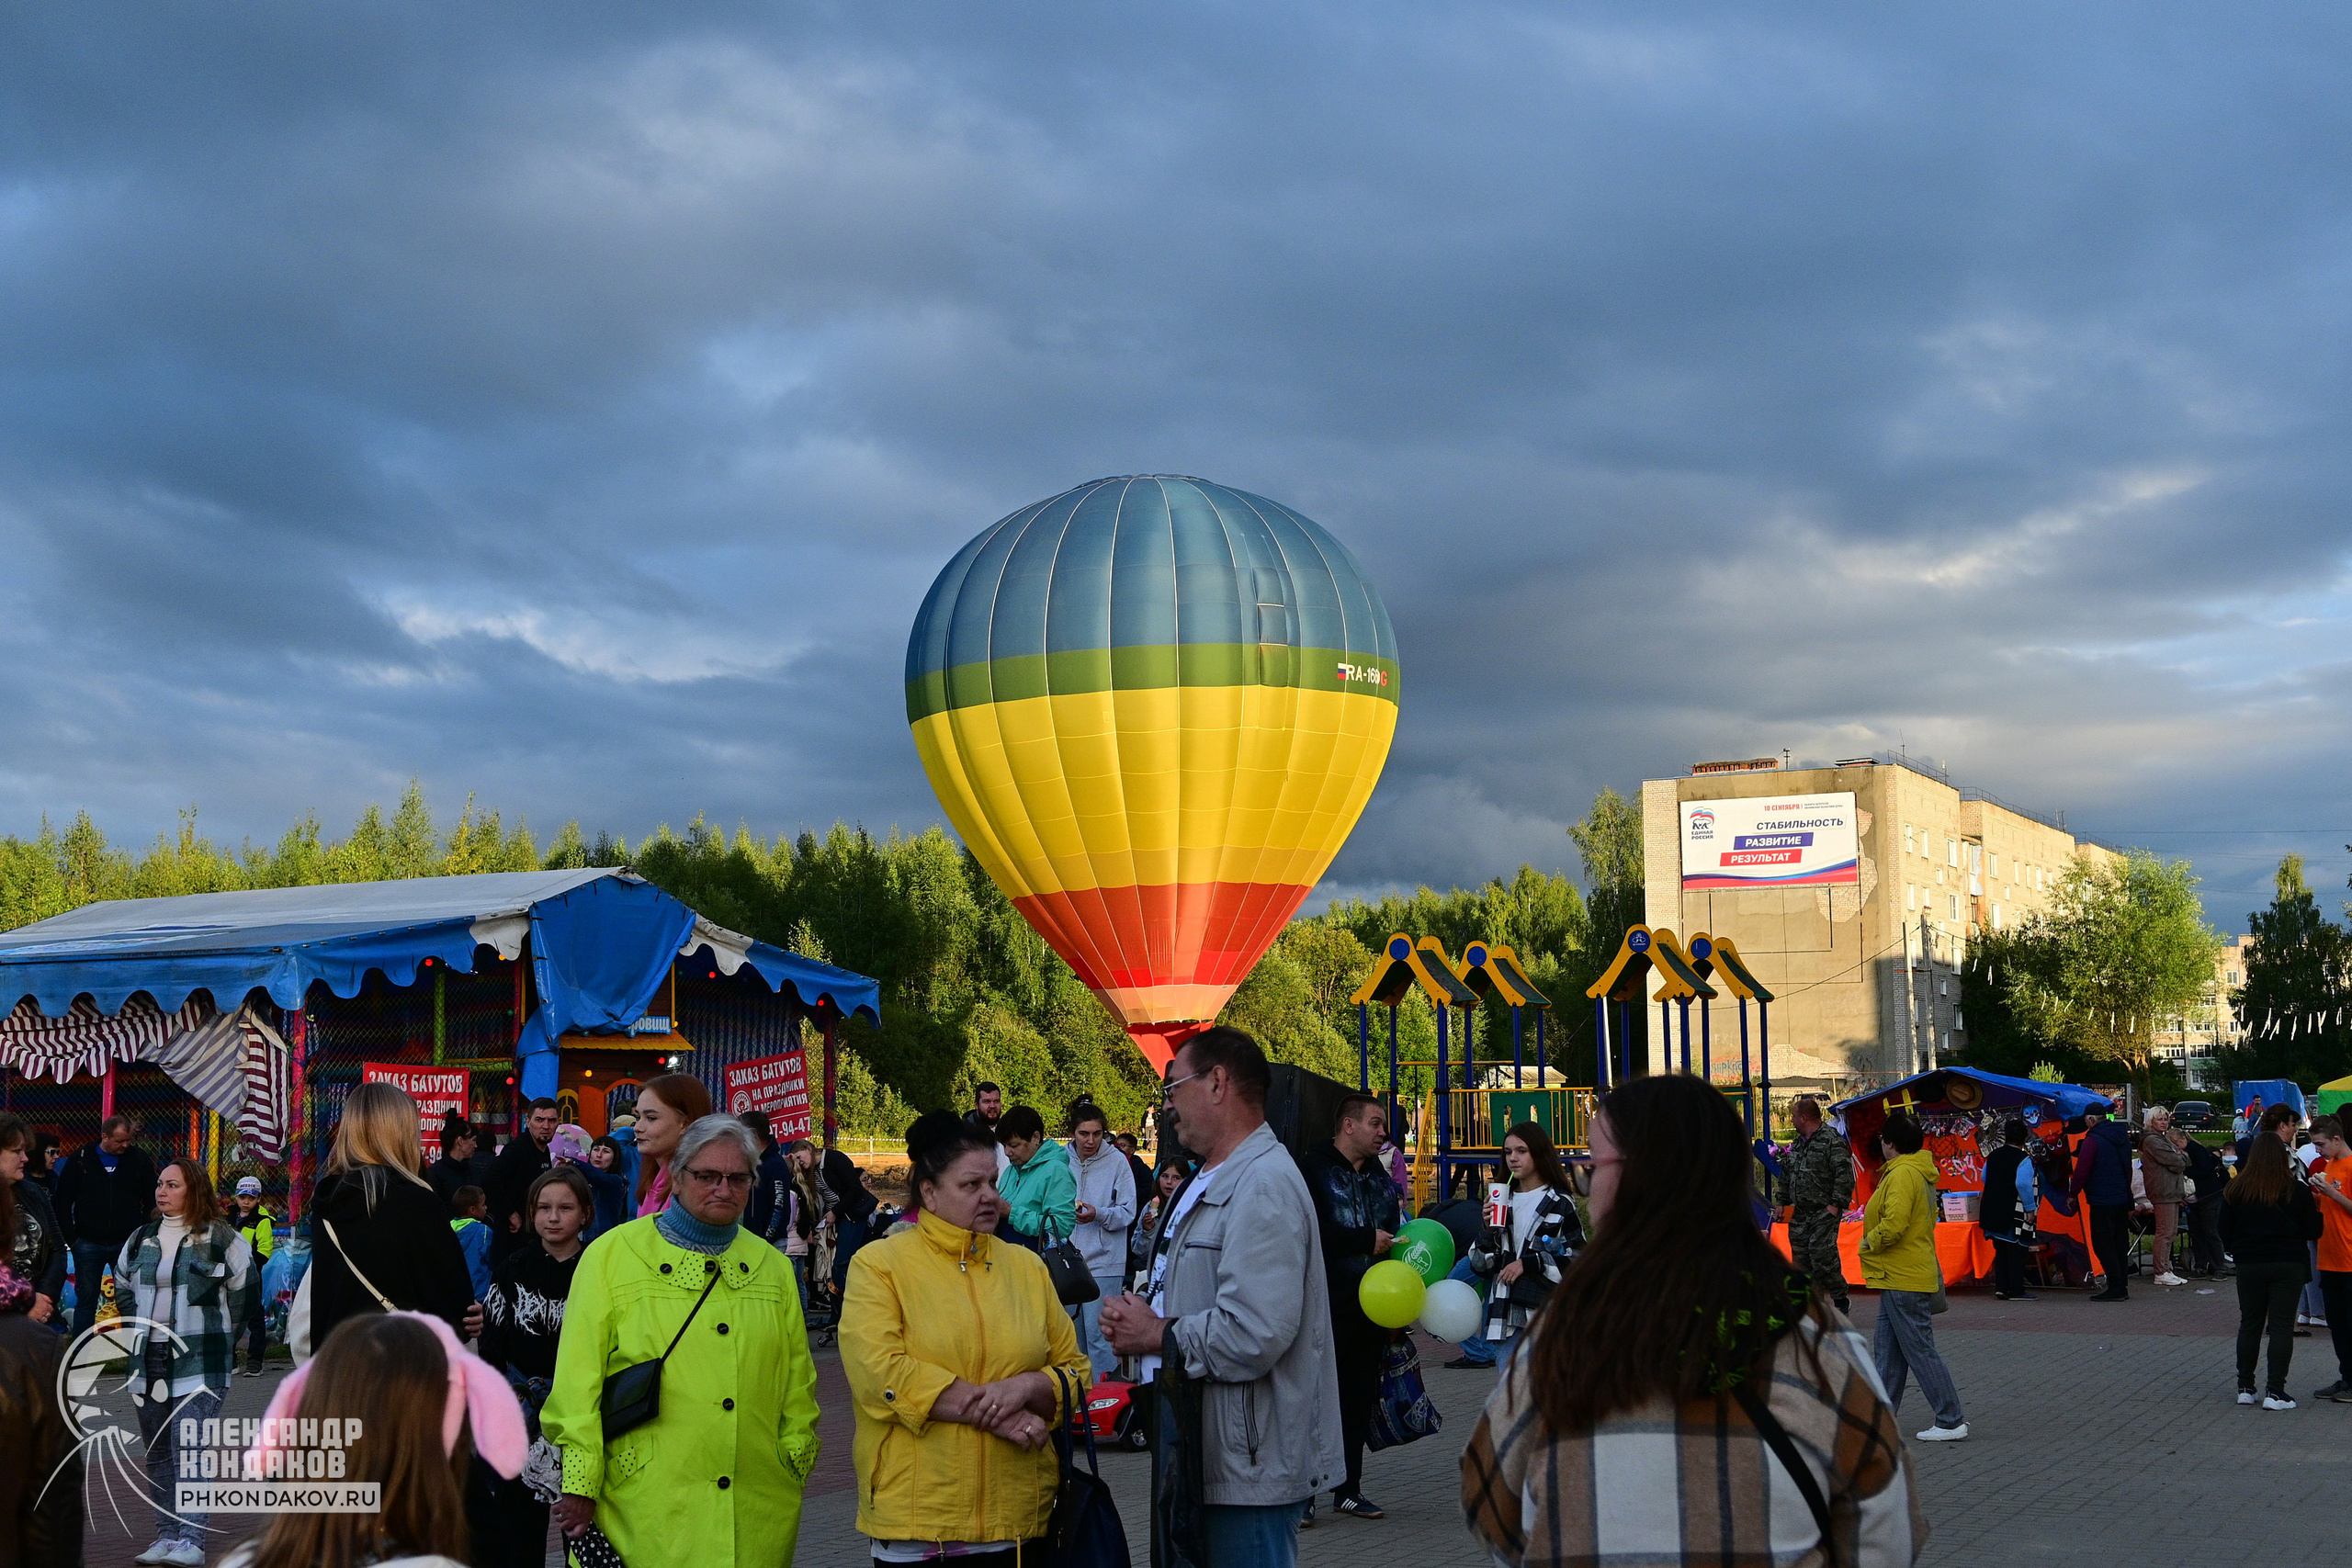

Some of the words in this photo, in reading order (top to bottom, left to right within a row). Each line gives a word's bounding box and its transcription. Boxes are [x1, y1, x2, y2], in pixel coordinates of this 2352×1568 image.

[1771, 803, 1801, 811] СЕНТЯБРЯ
[1756, 818, 1844, 830] СТАБИЛЬНОСТЬ
[1745, 835, 1802, 847] РАЗВИТИЕ
[1730, 852, 1792, 863] РЕЗУЛЬТАТ
[628, 1017, 671, 1035] ровищ
[729, 1066, 760, 1088] ЗАКАЗ
[762, 1056, 802, 1080] БАТУТОВ
[411, 1074, 463, 1093] БАТУТОВ
[752, 1088, 763, 1101] НА
[763, 1077, 805, 1099] ПРАЗДНИКИ
[761, 1093, 808, 1113] МЕРОПРИЯТИЯ
